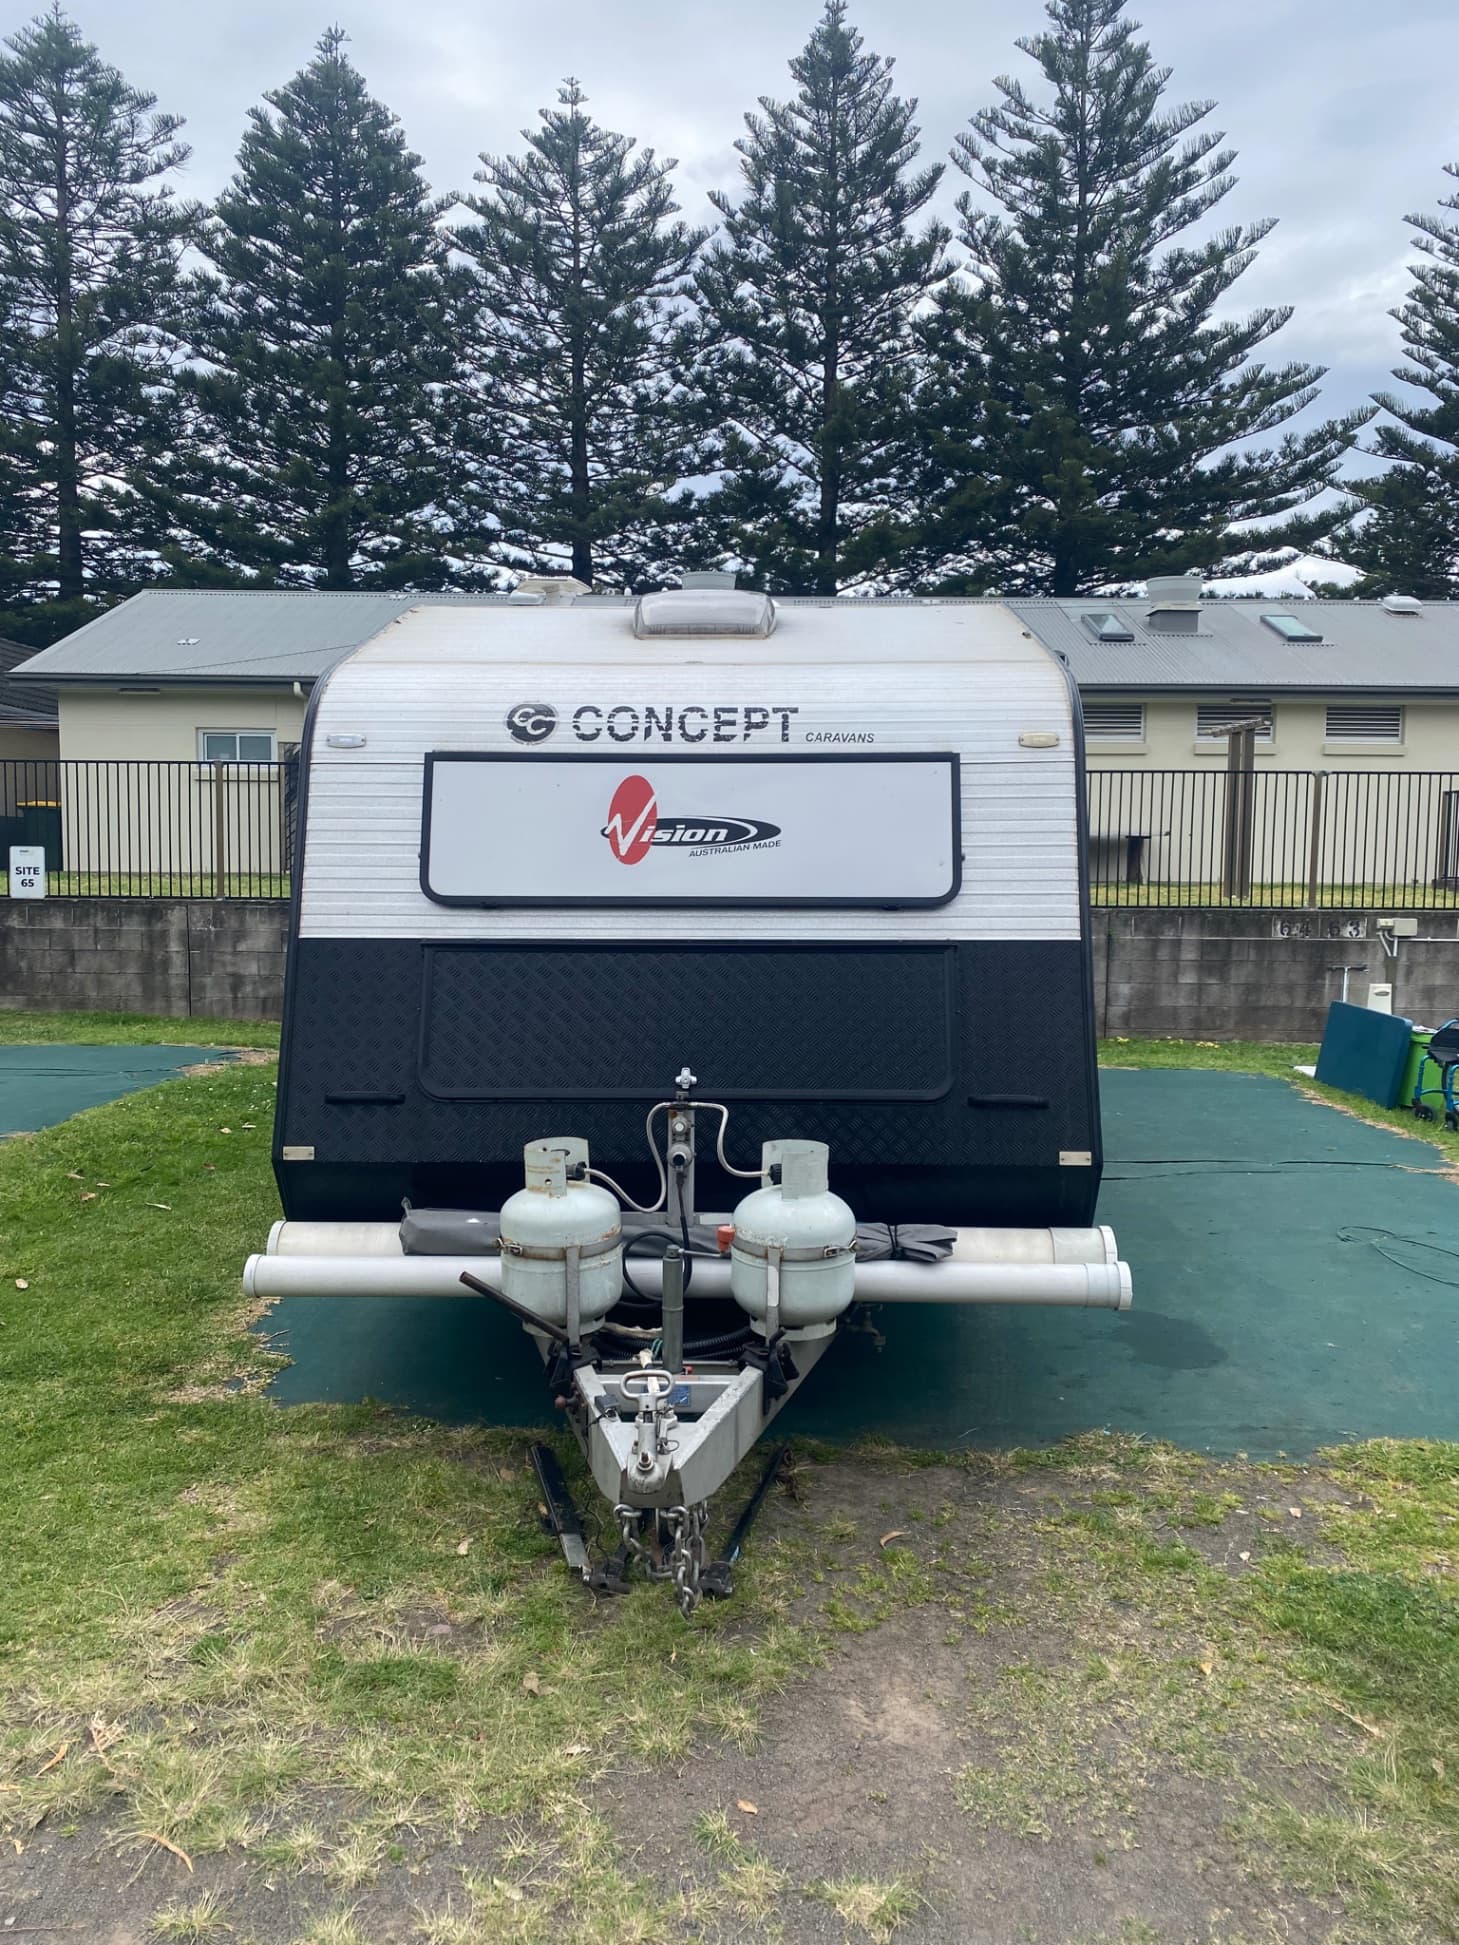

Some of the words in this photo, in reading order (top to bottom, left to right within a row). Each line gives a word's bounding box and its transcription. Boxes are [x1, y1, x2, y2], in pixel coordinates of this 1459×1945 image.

[572, 705, 799, 742] CONCEPT
[805, 732, 875, 743] CARAVANS
[604, 794, 728, 857] Vision
[688, 843, 750, 858] AUSTRALIAN
[752, 839, 782, 850] MADE
[15, 866, 41, 876] SITE
[20, 878, 35, 888] 65
[1327, 920, 1360, 937] 63
